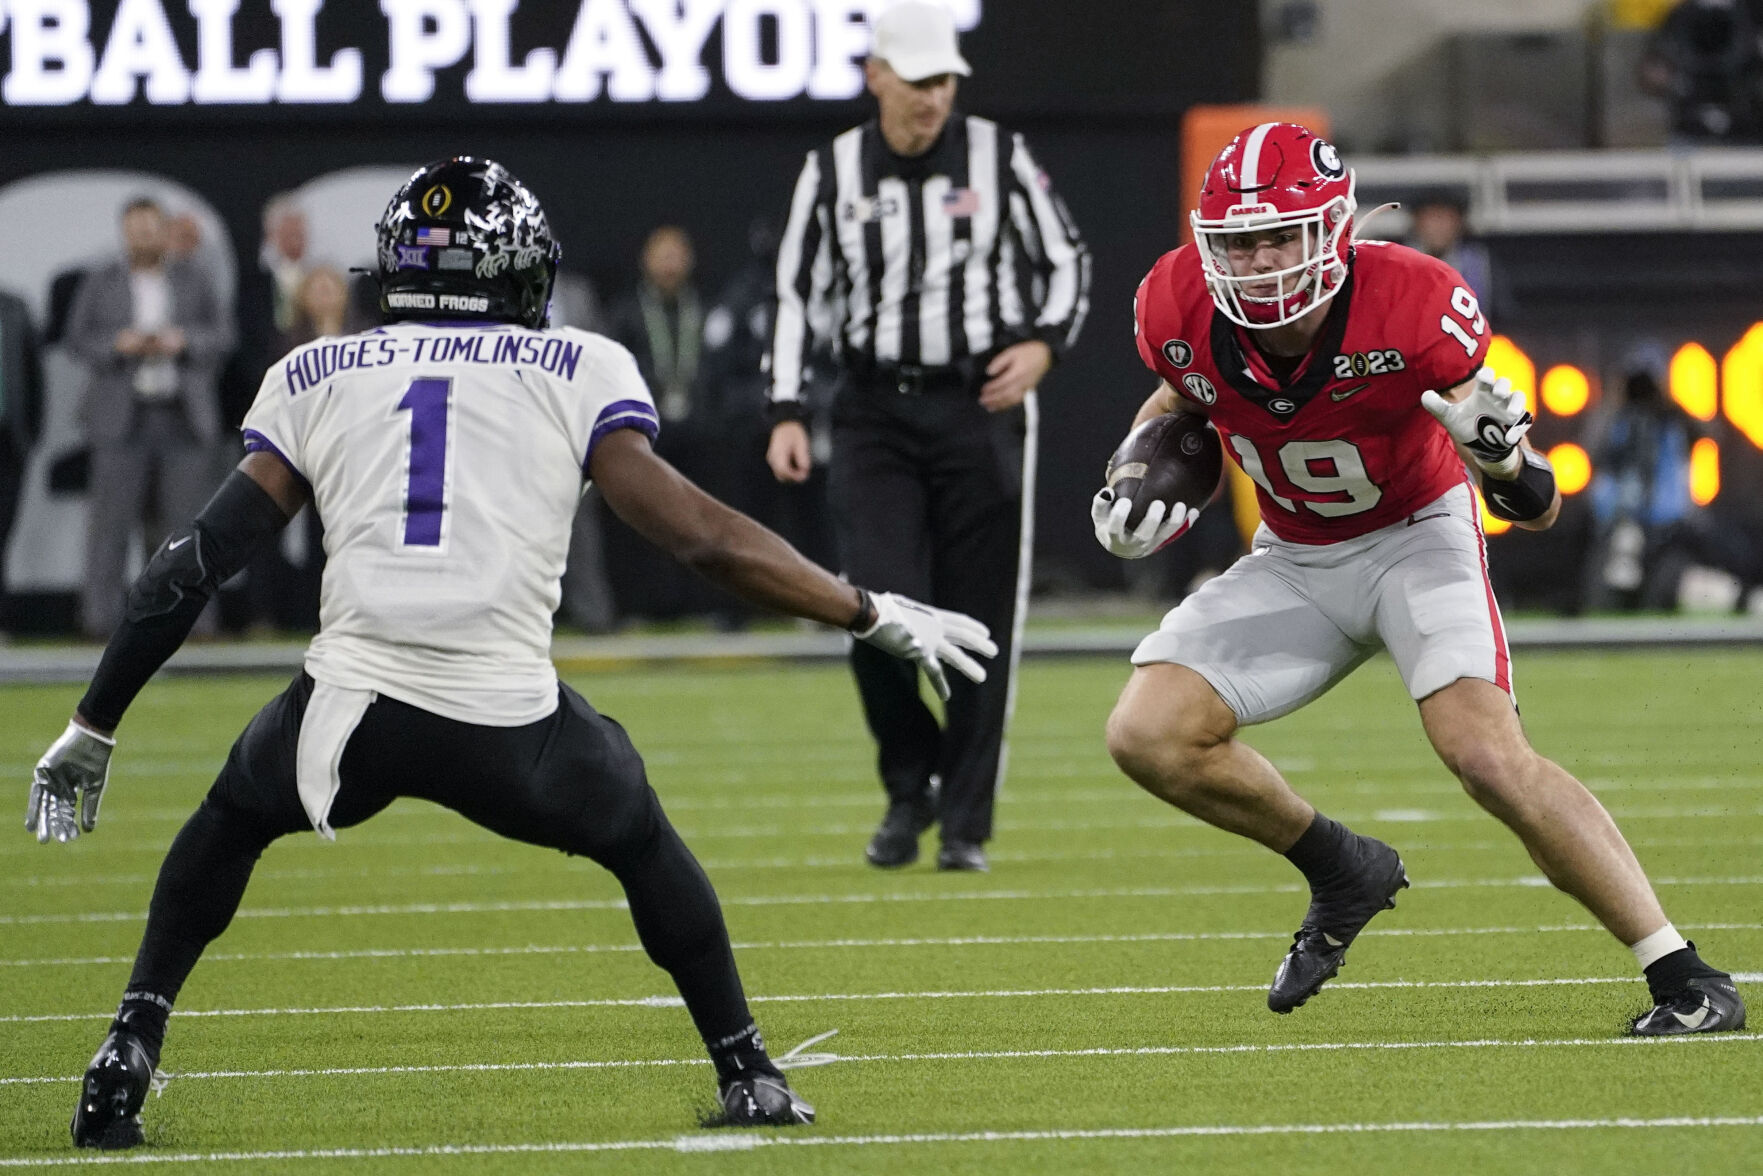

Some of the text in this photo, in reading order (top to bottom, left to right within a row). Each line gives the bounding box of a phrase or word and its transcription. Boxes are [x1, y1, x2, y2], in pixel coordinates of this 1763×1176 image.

[0, 0, 982, 105] BALL PLAYOF
[1231, 206, 1267, 216] DAWGS
[387, 293, 489, 312] HORNED FROGS
[1440, 286, 1486, 358] 19
[285, 335, 583, 396] HODGES-TOMLINSON
[1184, 375, 1215, 403] SEC
[391, 375, 455, 549] 1
[1230, 433, 1384, 518] 19
